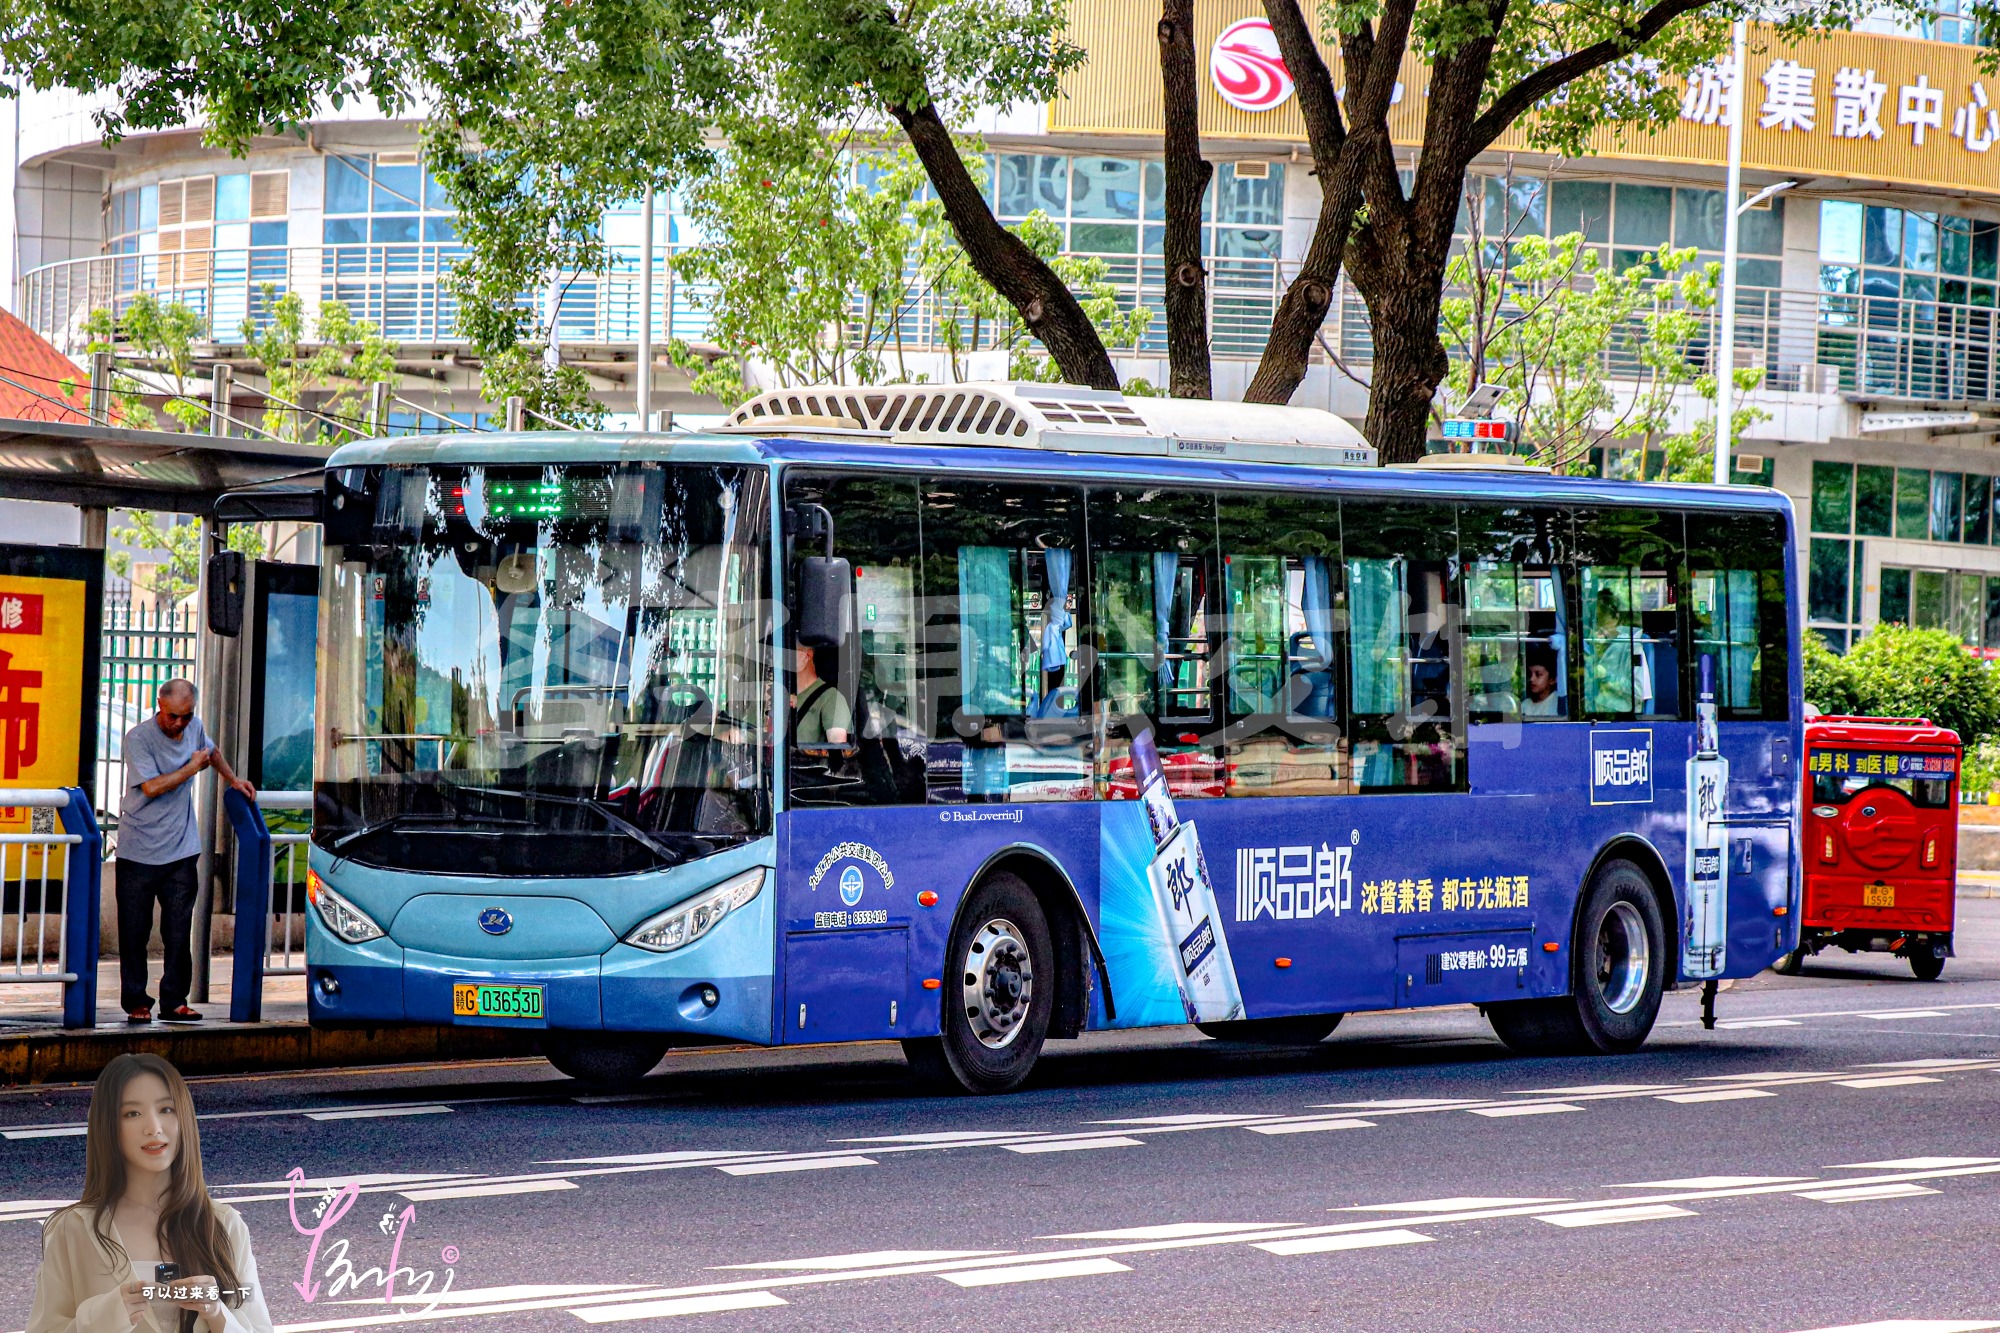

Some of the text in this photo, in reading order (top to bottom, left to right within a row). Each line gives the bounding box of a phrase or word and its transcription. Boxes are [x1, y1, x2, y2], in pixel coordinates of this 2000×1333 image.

[1600, 53, 2000, 152] 游集散中心
[1595, 748, 1648, 786] 顺品郎
[809, 841, 894, 891] 九江市公共交通集团公司
[1236, 841, 1353, 921] 顺品郎
[1361, 876, 1529, 915] 浓酱兼香 都市光瓶酒
